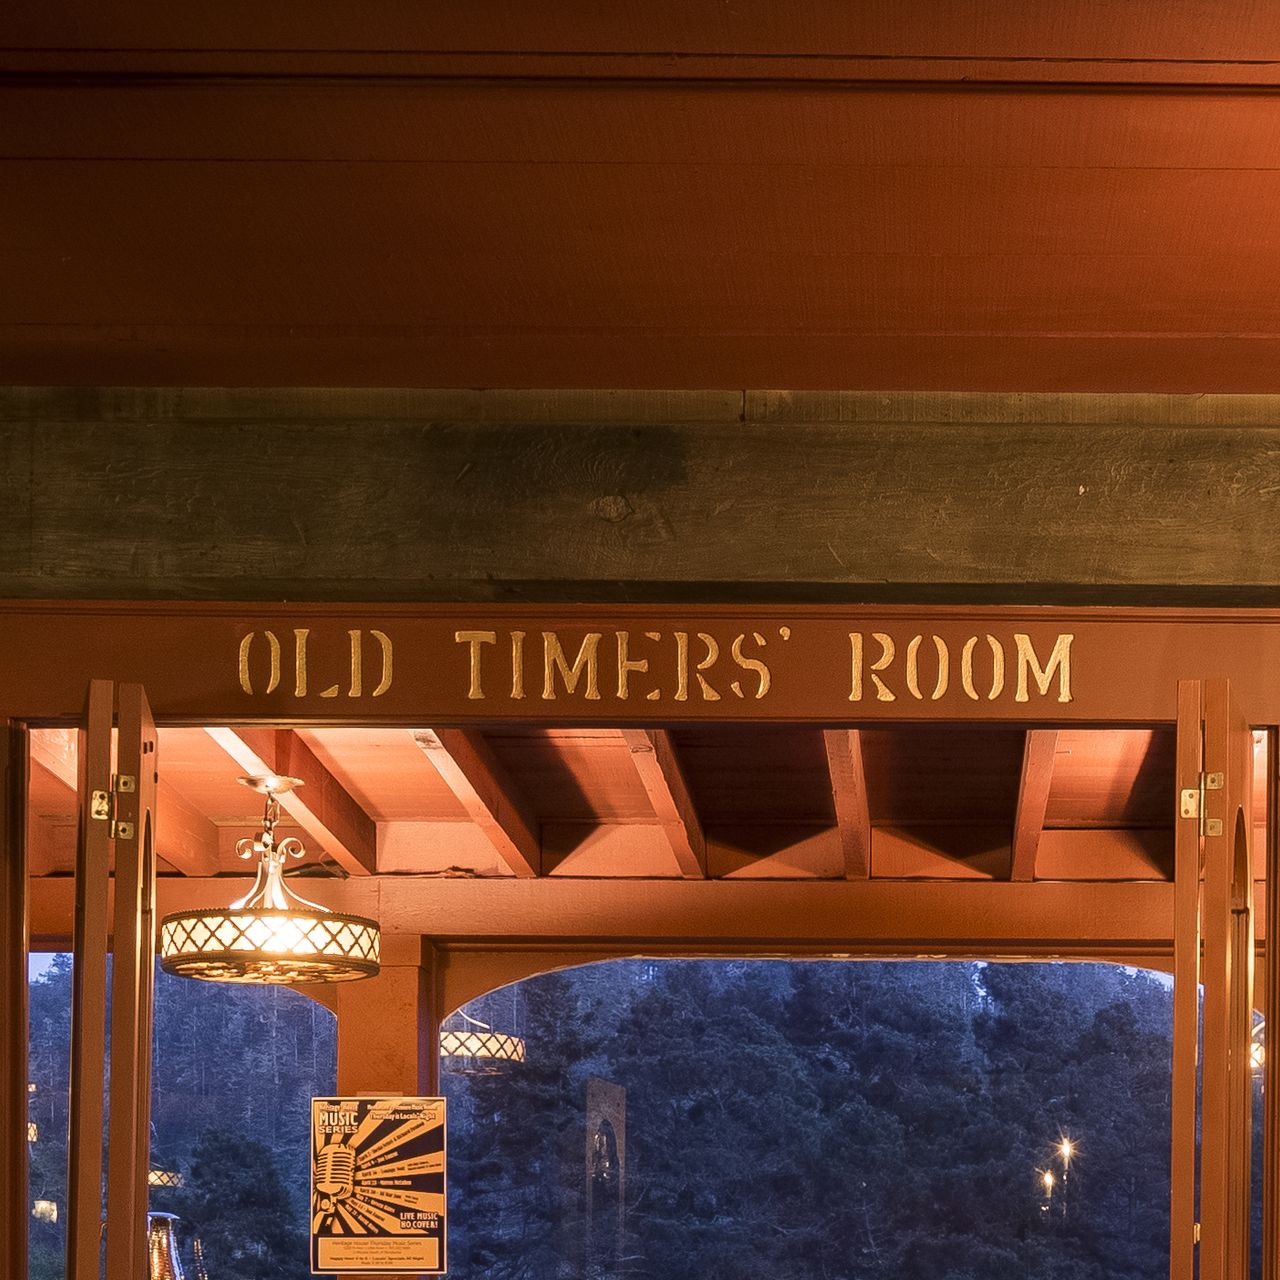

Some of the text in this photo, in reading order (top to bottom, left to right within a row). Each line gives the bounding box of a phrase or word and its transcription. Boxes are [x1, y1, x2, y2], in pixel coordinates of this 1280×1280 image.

[239, 628, 393, 698] OLD
[848, 632, 1074, 703] ROOM
[319, 1111, 358, 1126] MUSIC
[318, 1125, 358, 1134] SERIES
[400, 1212, 438, 1220] LIVE MUSIC
[400, 1221, 438, 1229] NO COVER!
